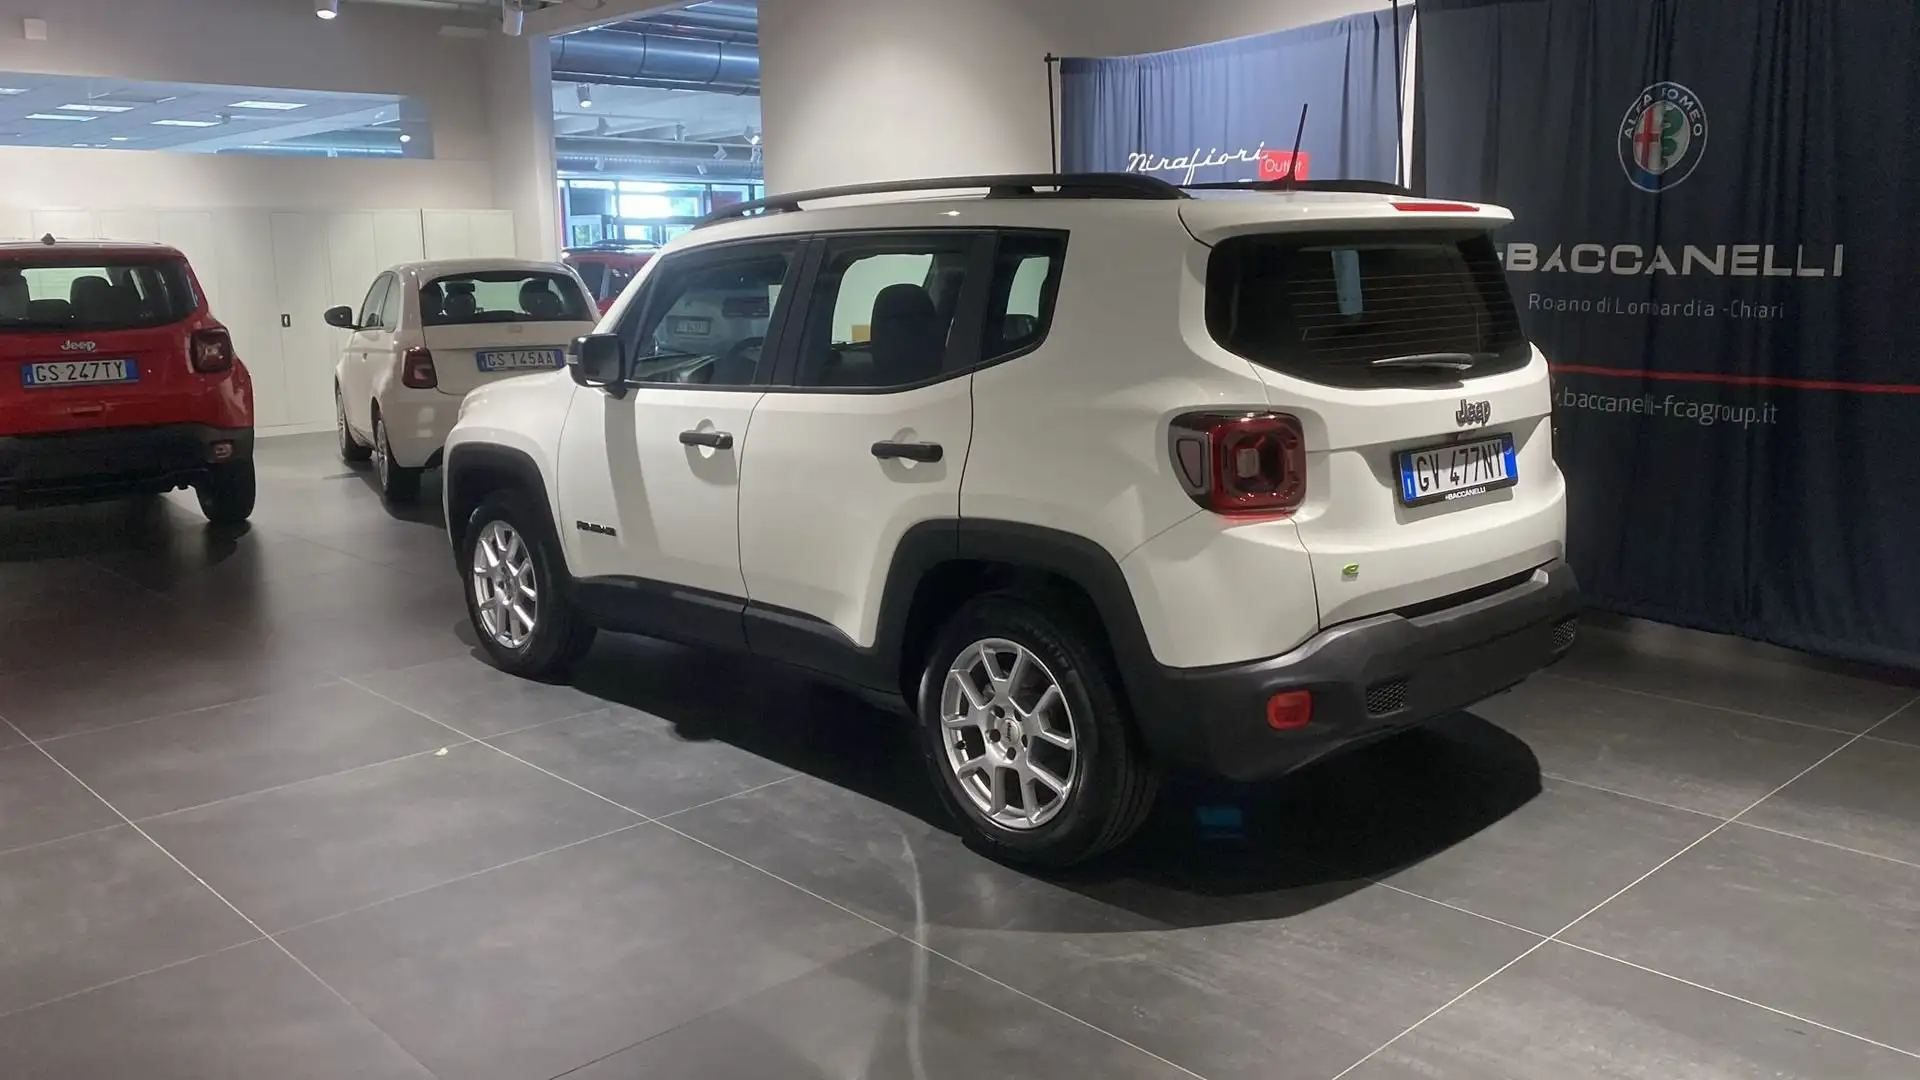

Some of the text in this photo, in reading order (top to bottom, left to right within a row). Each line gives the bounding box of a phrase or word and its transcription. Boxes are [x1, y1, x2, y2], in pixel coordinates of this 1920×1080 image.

[1265, 159, 1305, 172] Outlt
[1506, 243, 1843, 276] BACCANELLI
[61, 340, 96, 351] Jeep
[36, 365, 59, 382] GS
[67, 361, 122, 380] 247TY
[1456, 399, 1491, 427] Jeep
[1416, 453, 1439, 492] GV
[1449, 441, 1502, 486] 477NY
